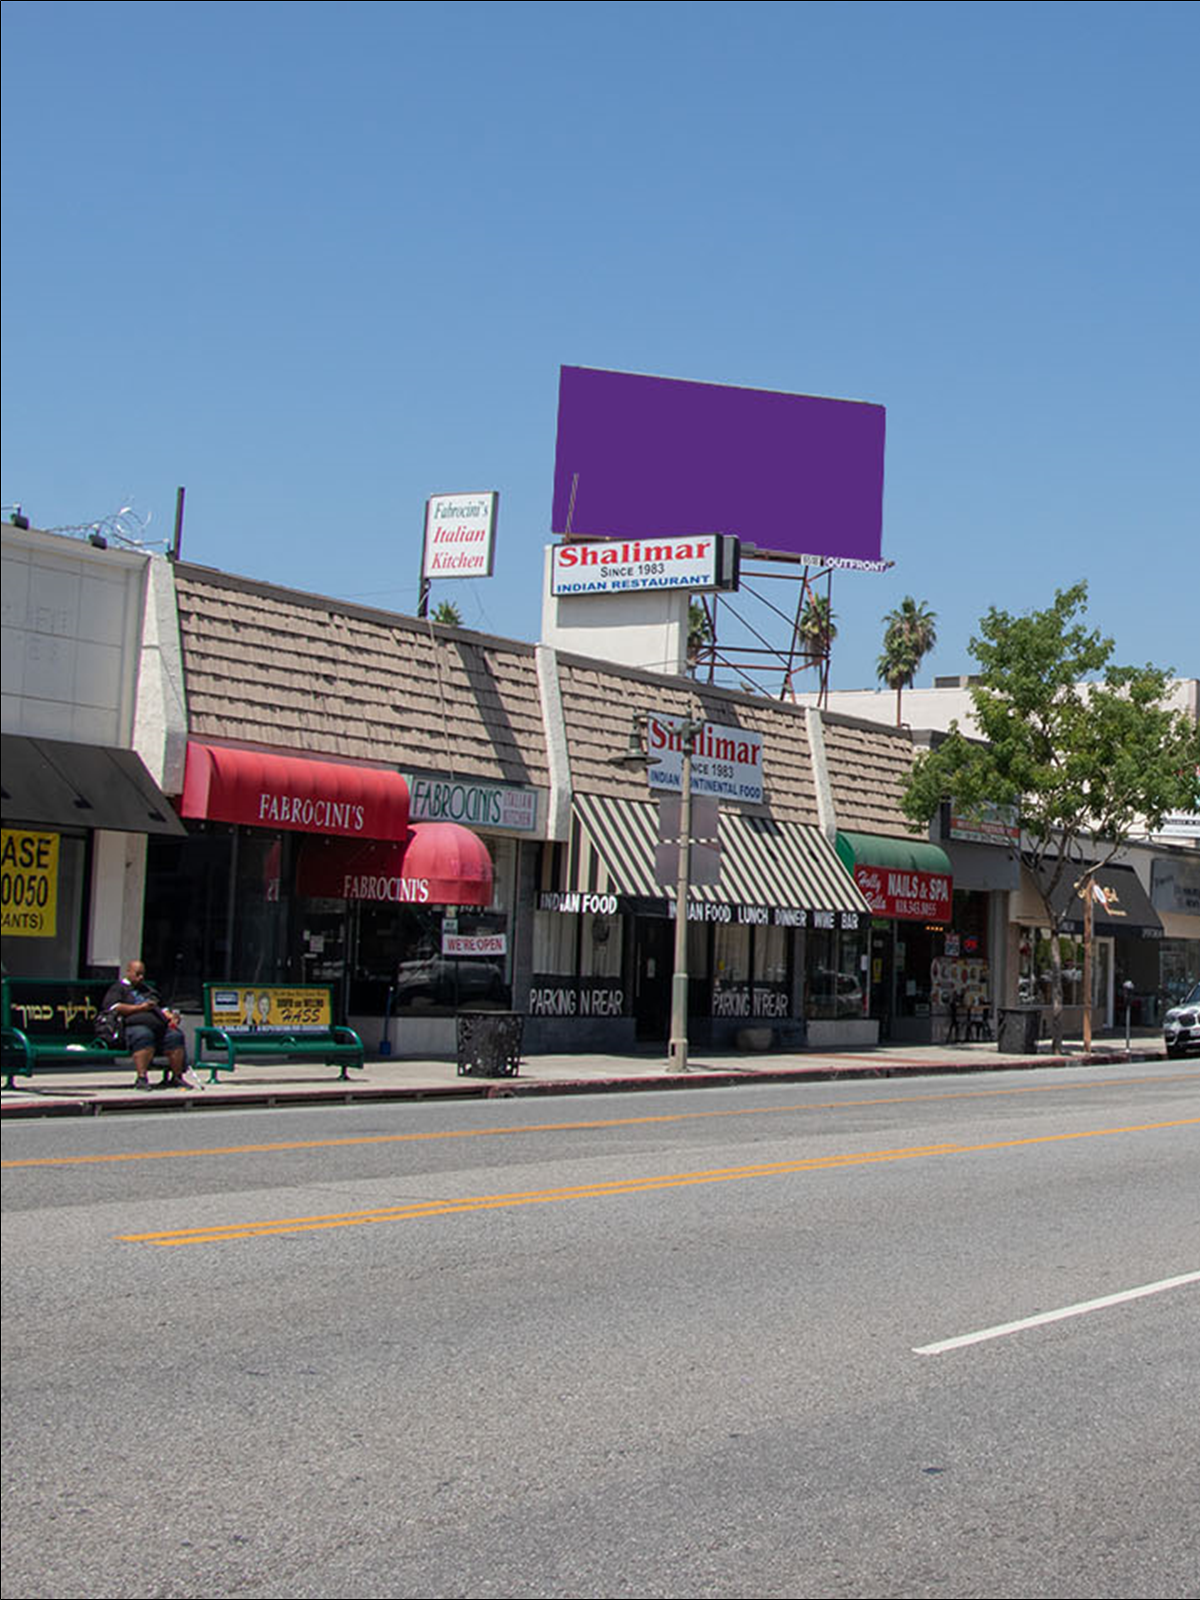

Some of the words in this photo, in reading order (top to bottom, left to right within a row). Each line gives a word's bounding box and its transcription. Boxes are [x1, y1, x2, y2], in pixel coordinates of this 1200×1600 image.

[434, 526, 485, 543] Italian
[431, 552, 484, 569] Kitchen
[558, 542, 711, 568] Shalimar
[600, 566, 634, 578] SINCE
[638, 563, 665, 575] 1983
[557, 581, 607, 593] INDIAN
[612, 574, 711, 589] RESTAURANT
[711, 763, 734, 779] 1983
[650, 769, 681, 787] INDIAN
[682, 776, 738, 796] NTINENTAL
[739, 784, 761, 799] FOOD
[258, 793, 365, 831] FABROCINI'S
[1, 872, 49, 908] 0050
[343, 874, 430, 903] FABROCINI'S
[887, 873, 919, 899] NAILS
[919, 881, 928, 899] &
[928, 878, 949, 902] SPA
[540, 892, 580, 913] INDIAN
[581, 894, 618, 915] FOOD
[668, 900, 703, 920] INIAN
[704, 902, 732, 923] FOOD
[737, 905, 769, 925] LUNCH
[774, 908, 807, 927] DINNER
[813, 911, 835, 929] WINE
[841, 912, 859, 930] BAR
[0, 912, 45, 930] ANTS)
[476, 937, 503, 952] OPEN
[529, 988, 577, 1015] PARKING
[591, 989, 625, 1015] REAR
[762, 993, 789, 1017] REAR
